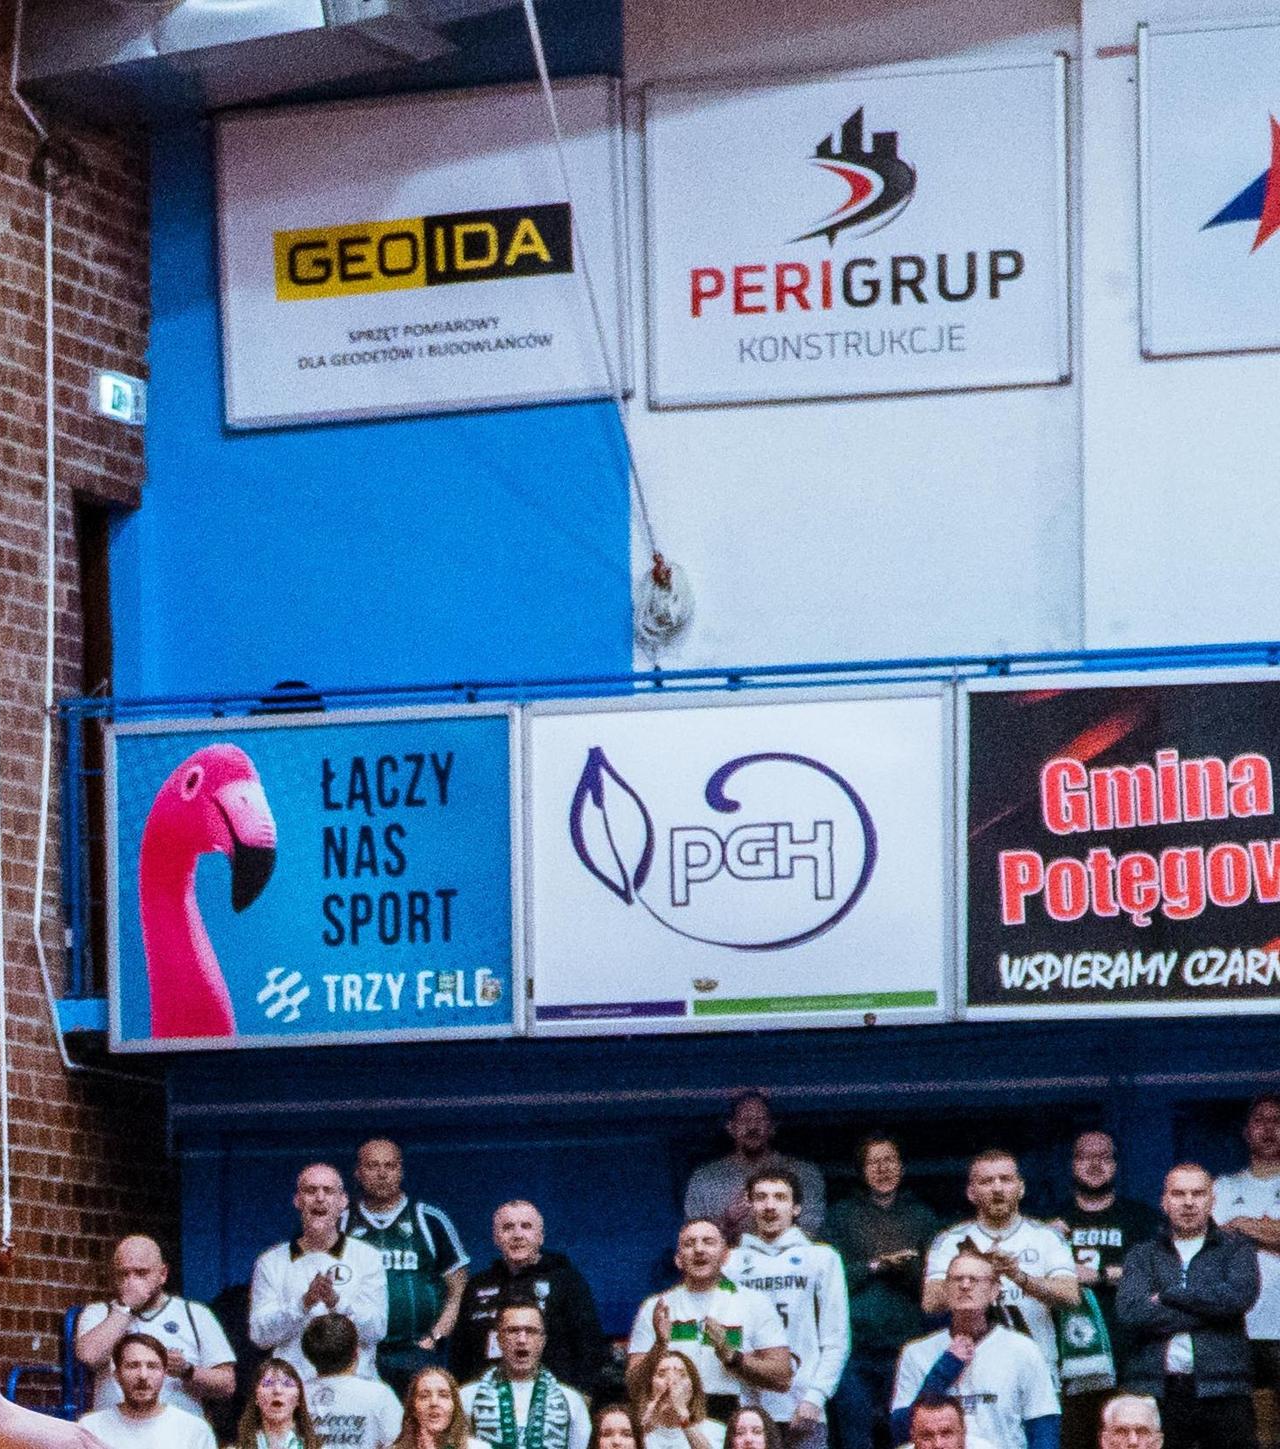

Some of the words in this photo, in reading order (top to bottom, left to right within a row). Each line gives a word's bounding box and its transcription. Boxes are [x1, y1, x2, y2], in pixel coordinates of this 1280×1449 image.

[290, 218, 552, 286] GEOIDA
[690, 250, 1025, 318] PERIGRUP
[403, 316, 500, 337] POMIAROWY
[739, 325, 966, 363] KONSTRUKCJE
[298, 355, 326, 370] DLA
[321, 752, 453, 816] ŁĄCZY
[1041, 748, 1275, 835] Gmina
[323, 823, 407, 879] NAS
[322, 889, 458, 946] SPORT
[323, 972, 405, 1012] TRZY
[1000, 951, 1178, 990] WSPIERAMY
[1073, 1229, 1123, 1247] EGIA
